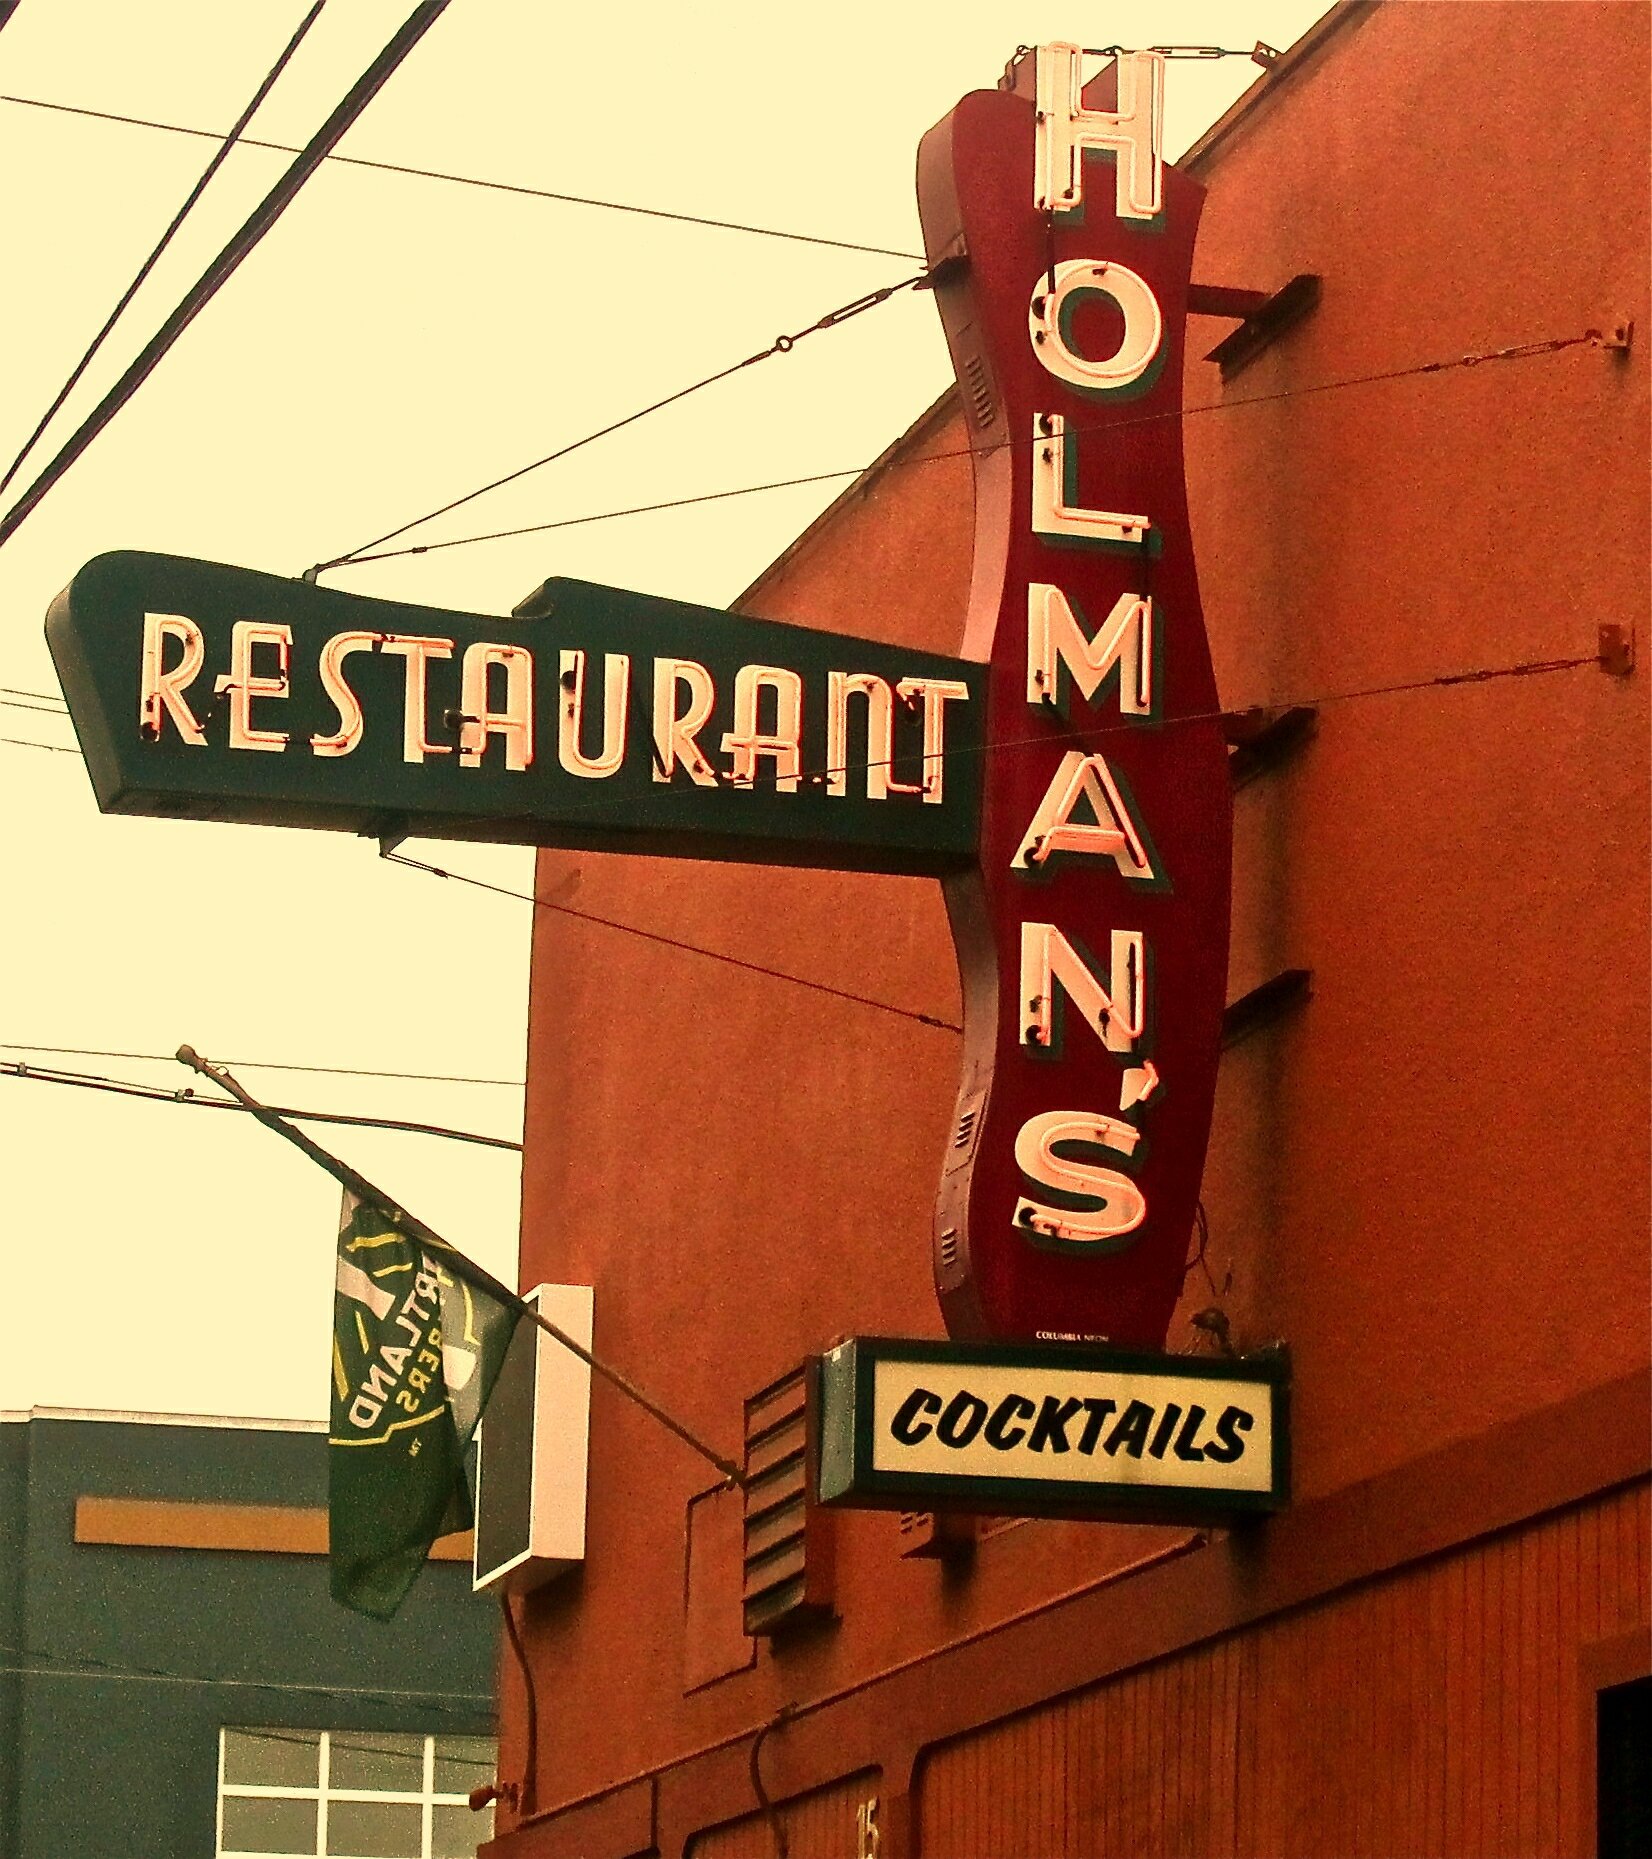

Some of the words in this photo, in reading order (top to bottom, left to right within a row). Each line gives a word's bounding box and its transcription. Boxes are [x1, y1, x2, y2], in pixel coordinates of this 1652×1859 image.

[138, 612, 970, 806] RESTAURANT
[1010, 42, 1167, 1243] HOLMAN'S
[890, 1388, 1254, 1464] COCKTAILS
